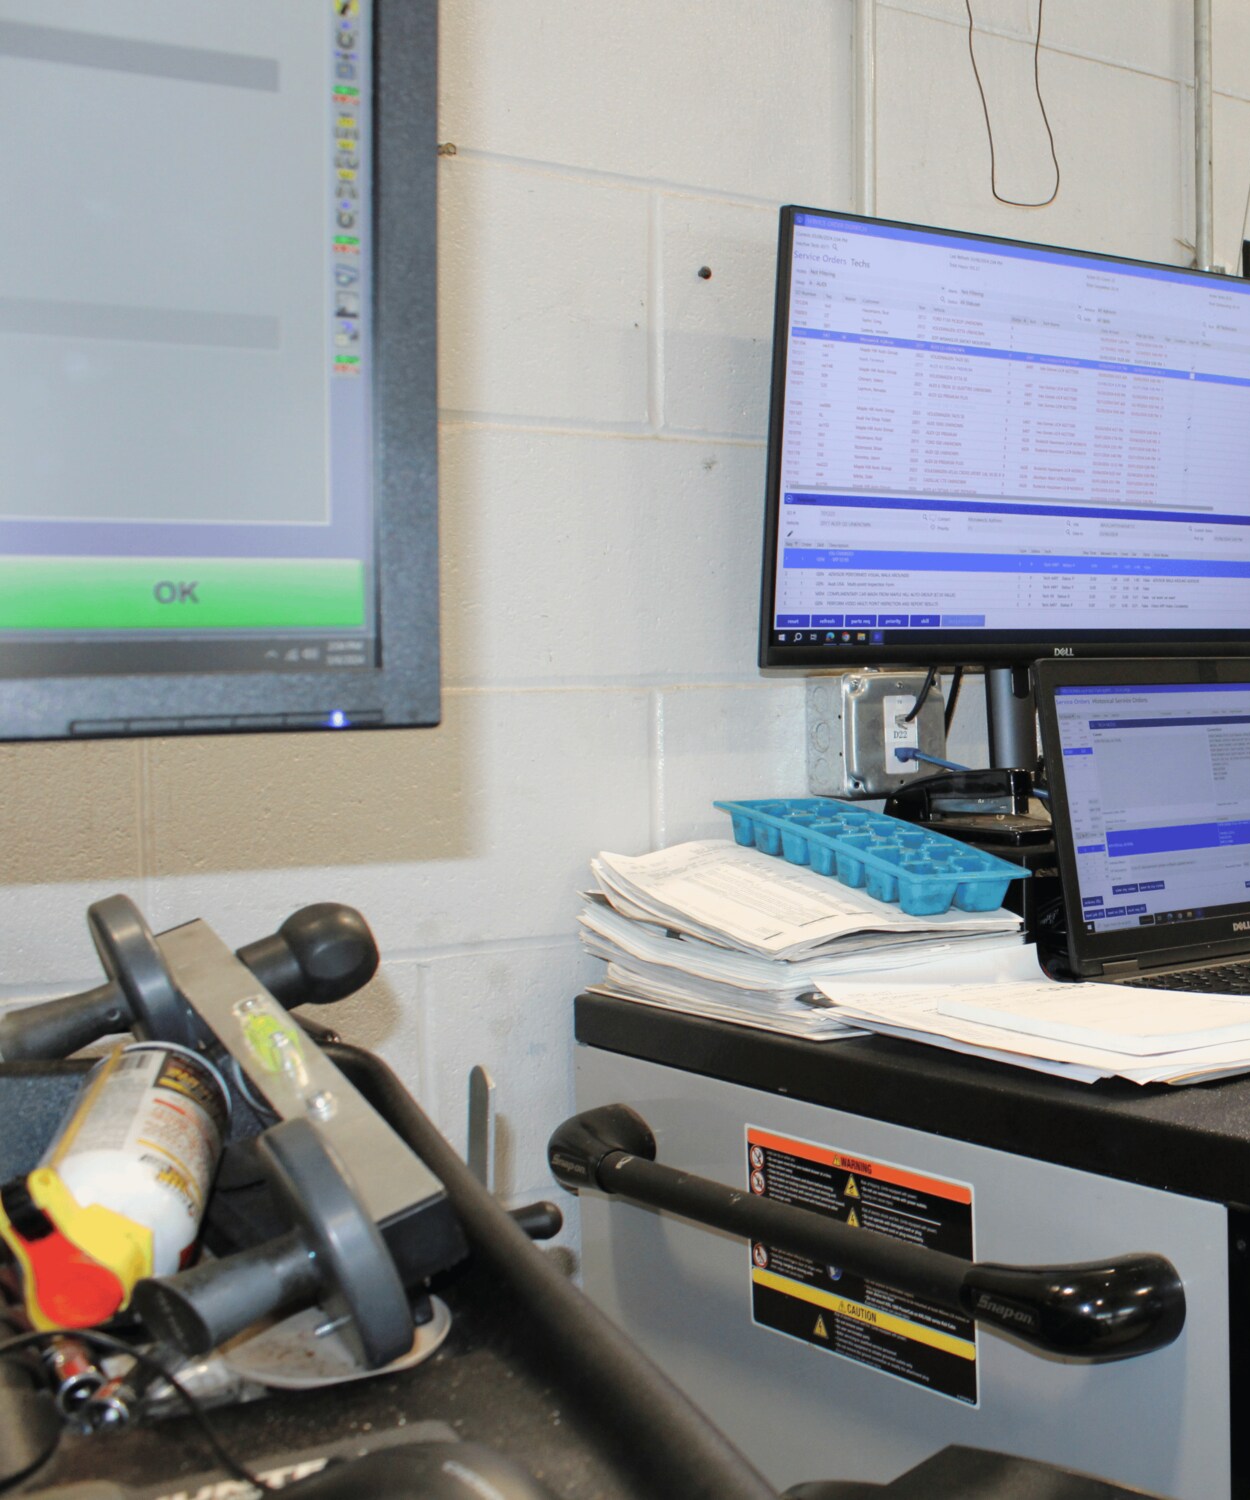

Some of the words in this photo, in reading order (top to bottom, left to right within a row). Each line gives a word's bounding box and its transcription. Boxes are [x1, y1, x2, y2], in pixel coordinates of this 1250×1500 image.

[793, 250, 820, 261] Service
[822, 254, 846, 264] Orders
[850, 258, 870, 268] Techs
[153, 580, 200, 606] OK
[1054, 648, 1074, 656] DELL
[840, 1156, 872, 1176] WARNING
[846, 1302, 877, 1323] CAUTION
